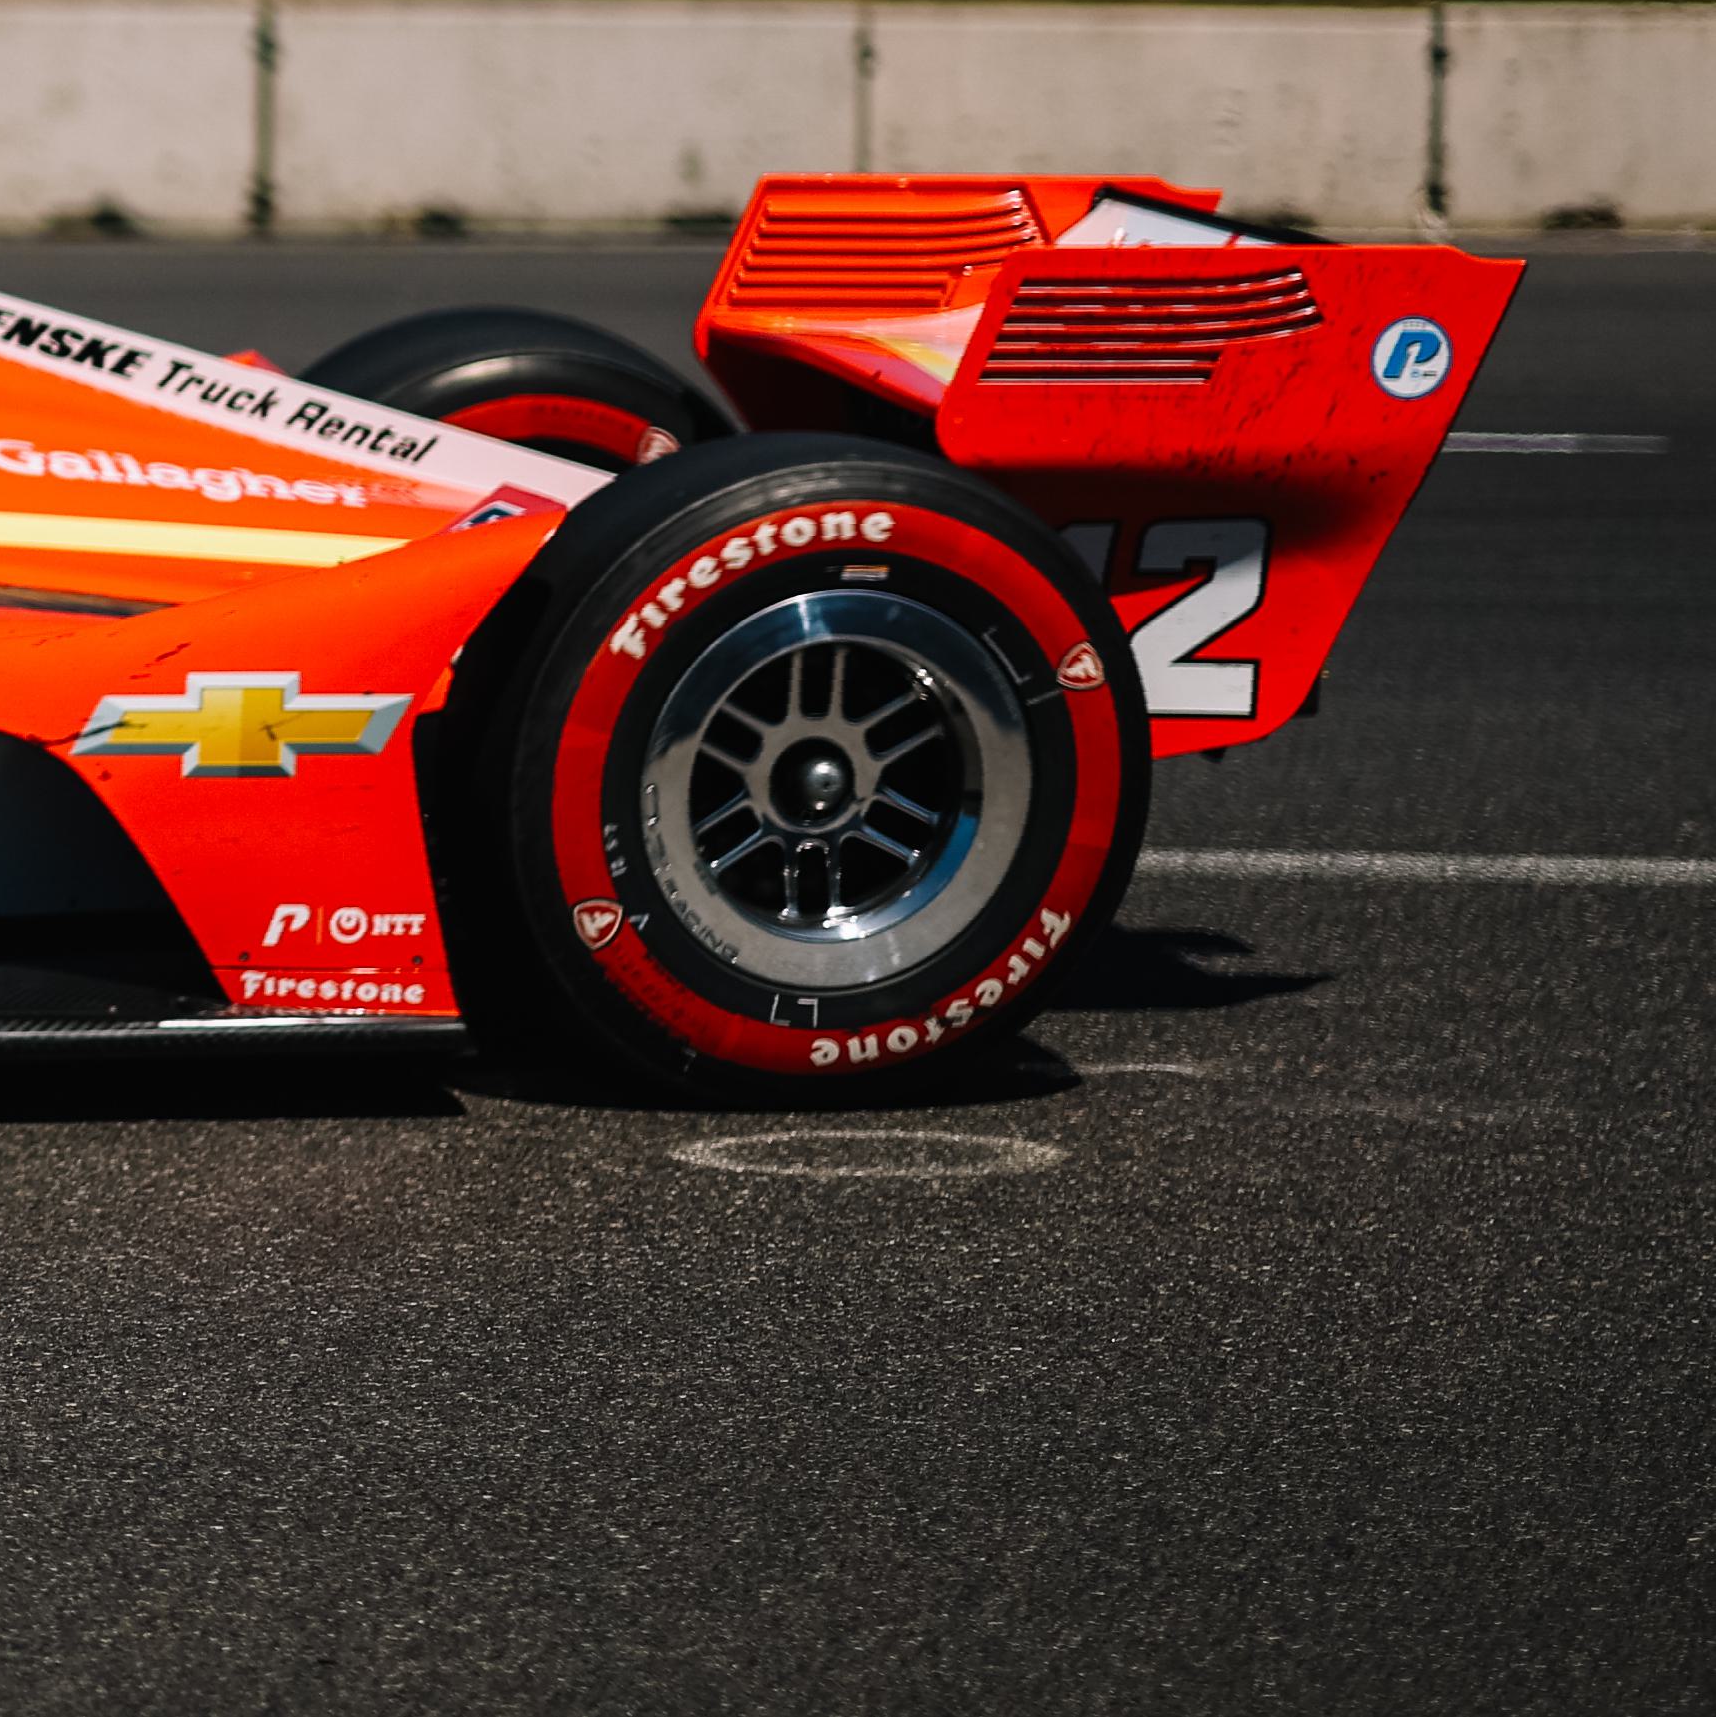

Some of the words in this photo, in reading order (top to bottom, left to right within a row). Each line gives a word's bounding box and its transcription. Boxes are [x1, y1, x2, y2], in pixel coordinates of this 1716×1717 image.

[157, 360, 279, 419] Truck
[285, 398, 439, 463] Rental
[610, 510, 896, 660] Firestone
[371, 913, 427, 936] NTT
[240, 970, 426, 1005] Firestone
[809, 907, 1072, 1067] Firestone
